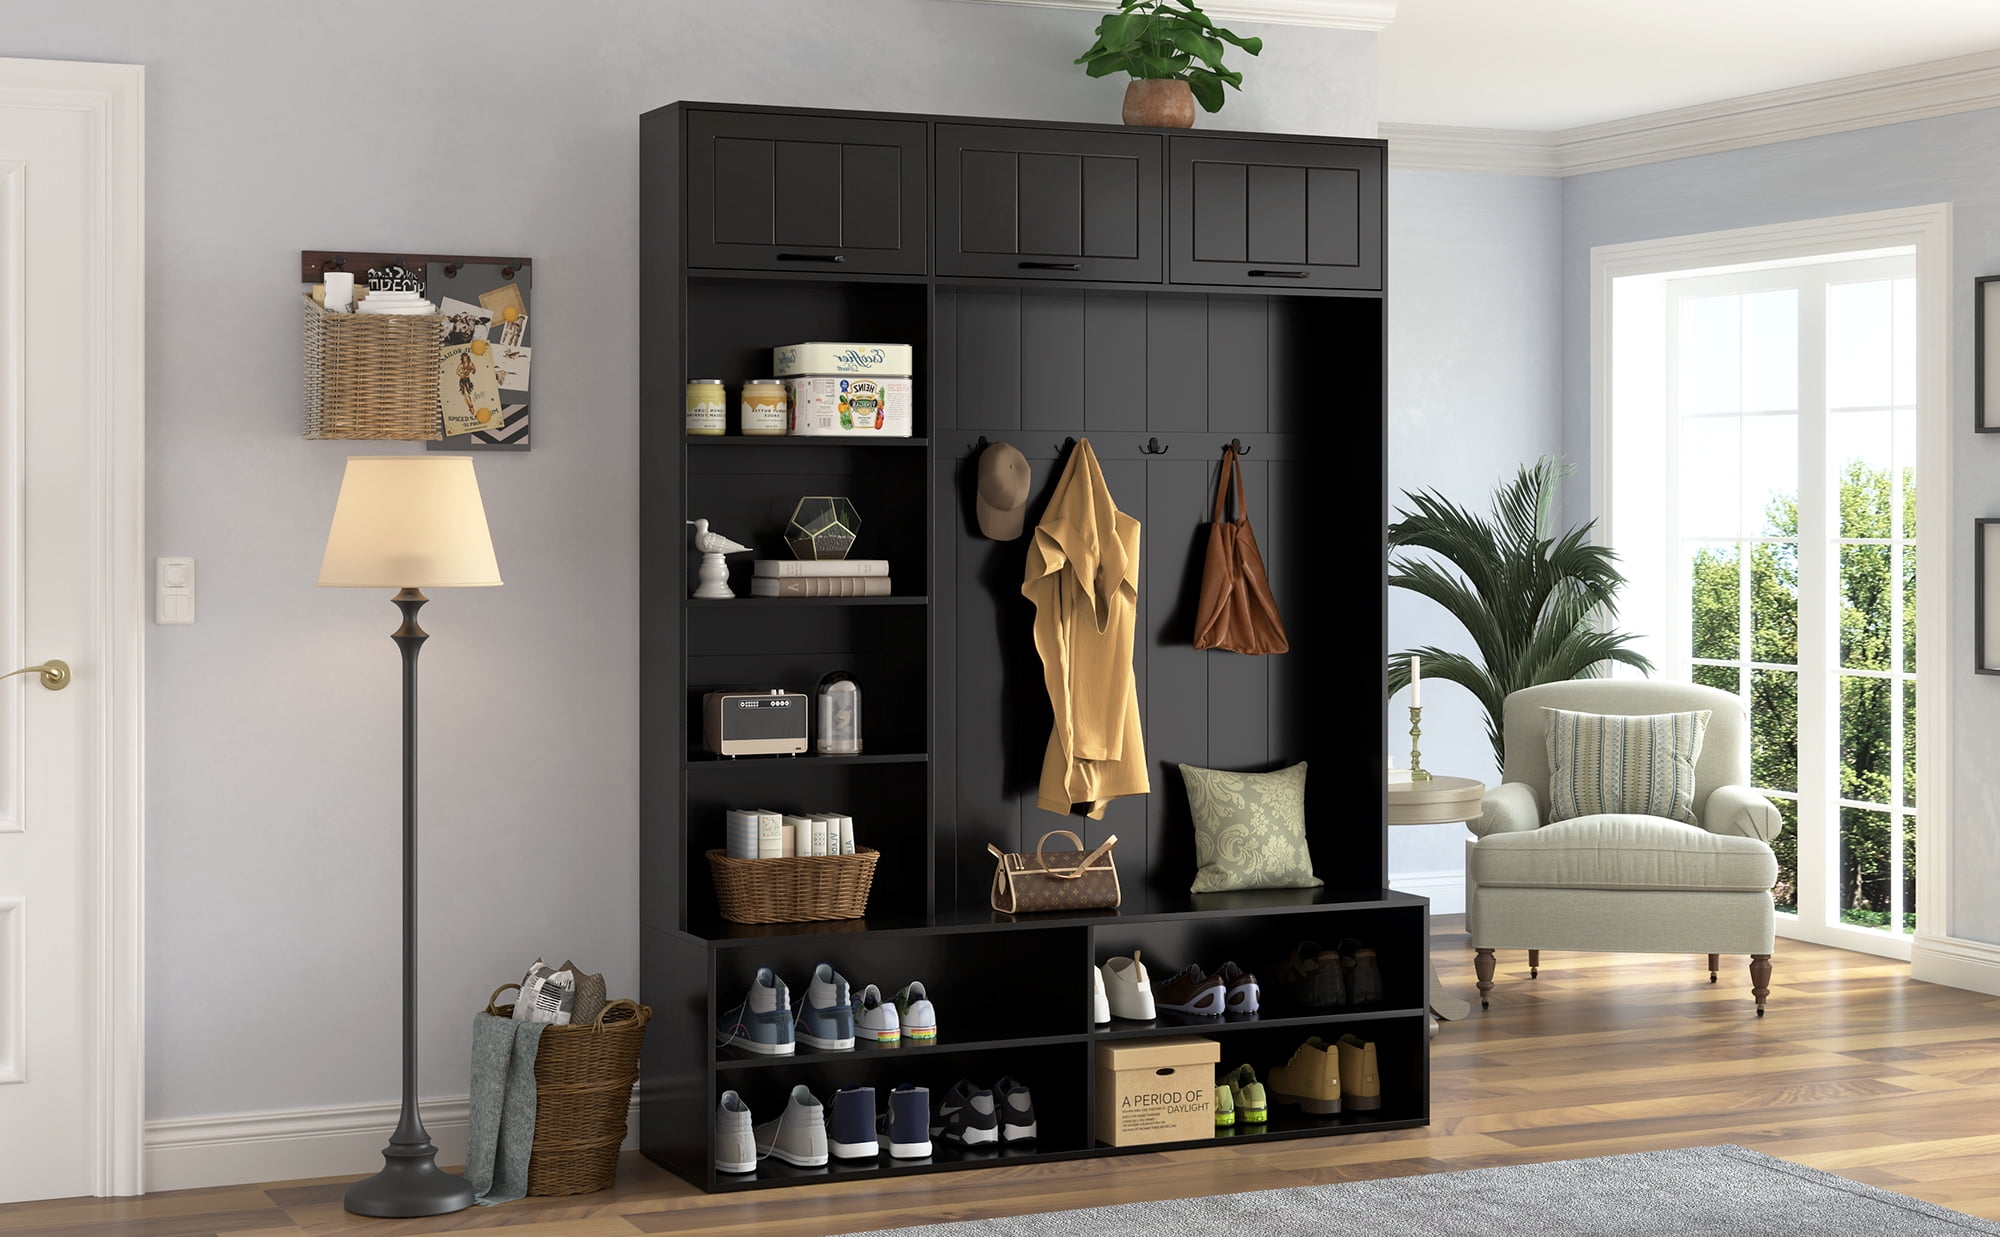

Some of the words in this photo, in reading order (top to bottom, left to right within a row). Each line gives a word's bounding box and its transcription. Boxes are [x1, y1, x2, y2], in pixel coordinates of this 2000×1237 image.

[1122, 1096, 1130, 1108] A
[1134, 1092, 1182, 1106] PERIOD
[1185, 1090, 1203, 1103] OF
[1167, 1102, 1210, 1114] DAYLIGHT
